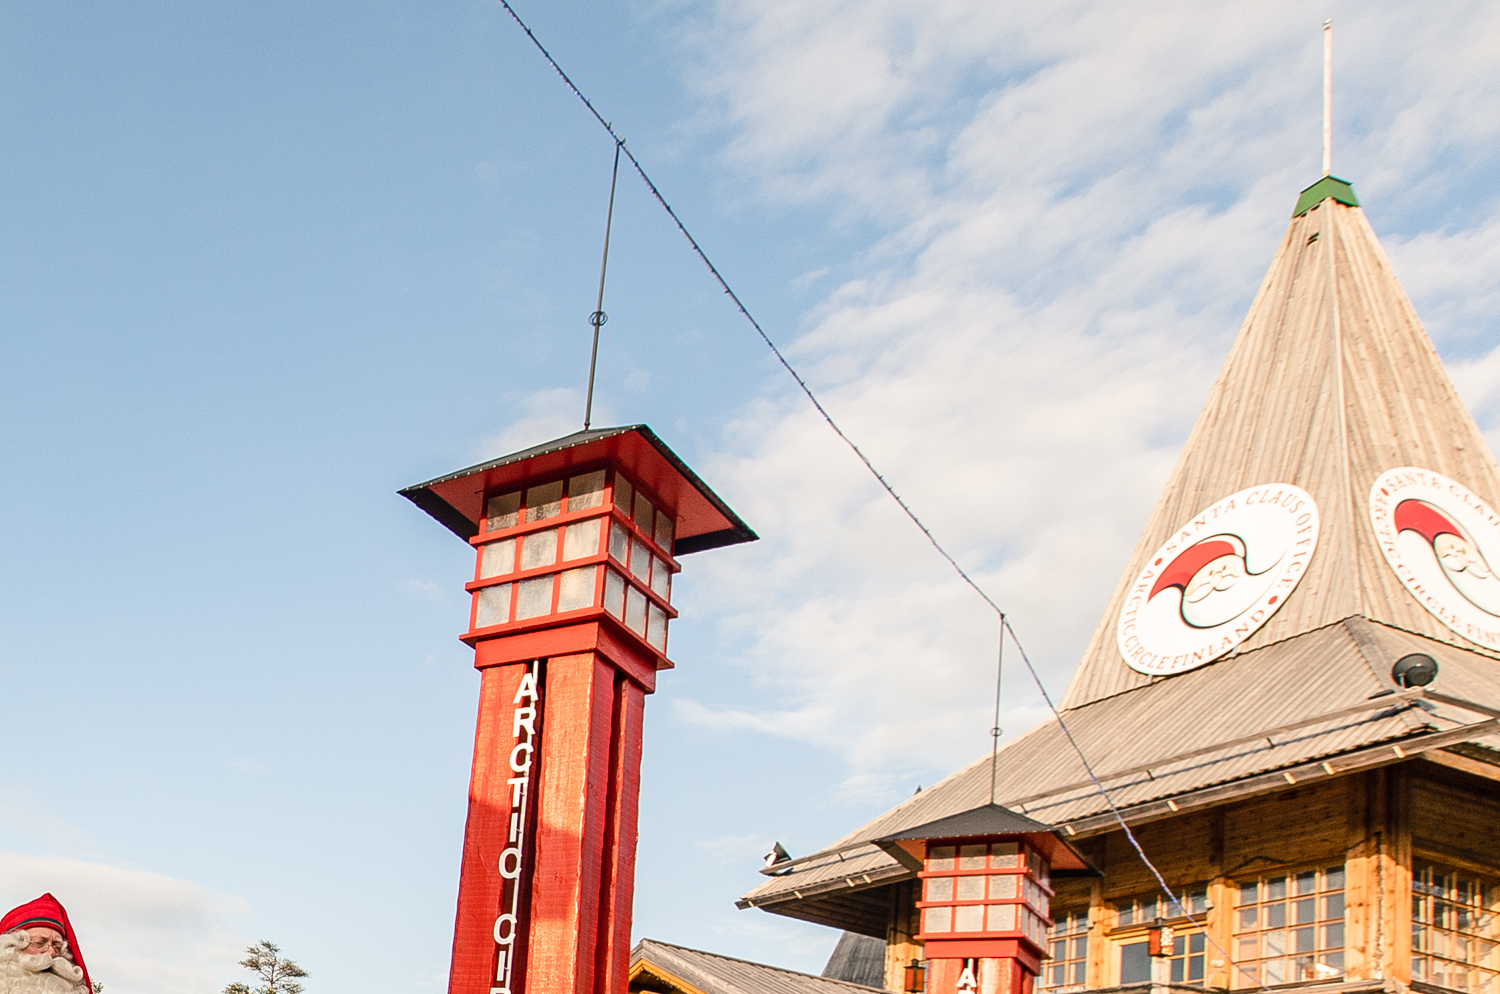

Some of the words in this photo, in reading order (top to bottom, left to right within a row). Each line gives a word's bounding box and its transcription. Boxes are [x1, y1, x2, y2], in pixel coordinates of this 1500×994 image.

[1166, 499, 1237, 554] SANTA
[1245, 489, 1305, 514] CLAUS
[1277, 512, 1313, 589] OFFICE
[1123, 570, 1155, 637] ARCTIC
[1397, 563, 1461, 628] CIRCLE
[1125, 635, 1170, 670] CIRCLE
[1170, 609, 1265, 669] FINLAND
[498, 672, 539, 881] ARCTIC
